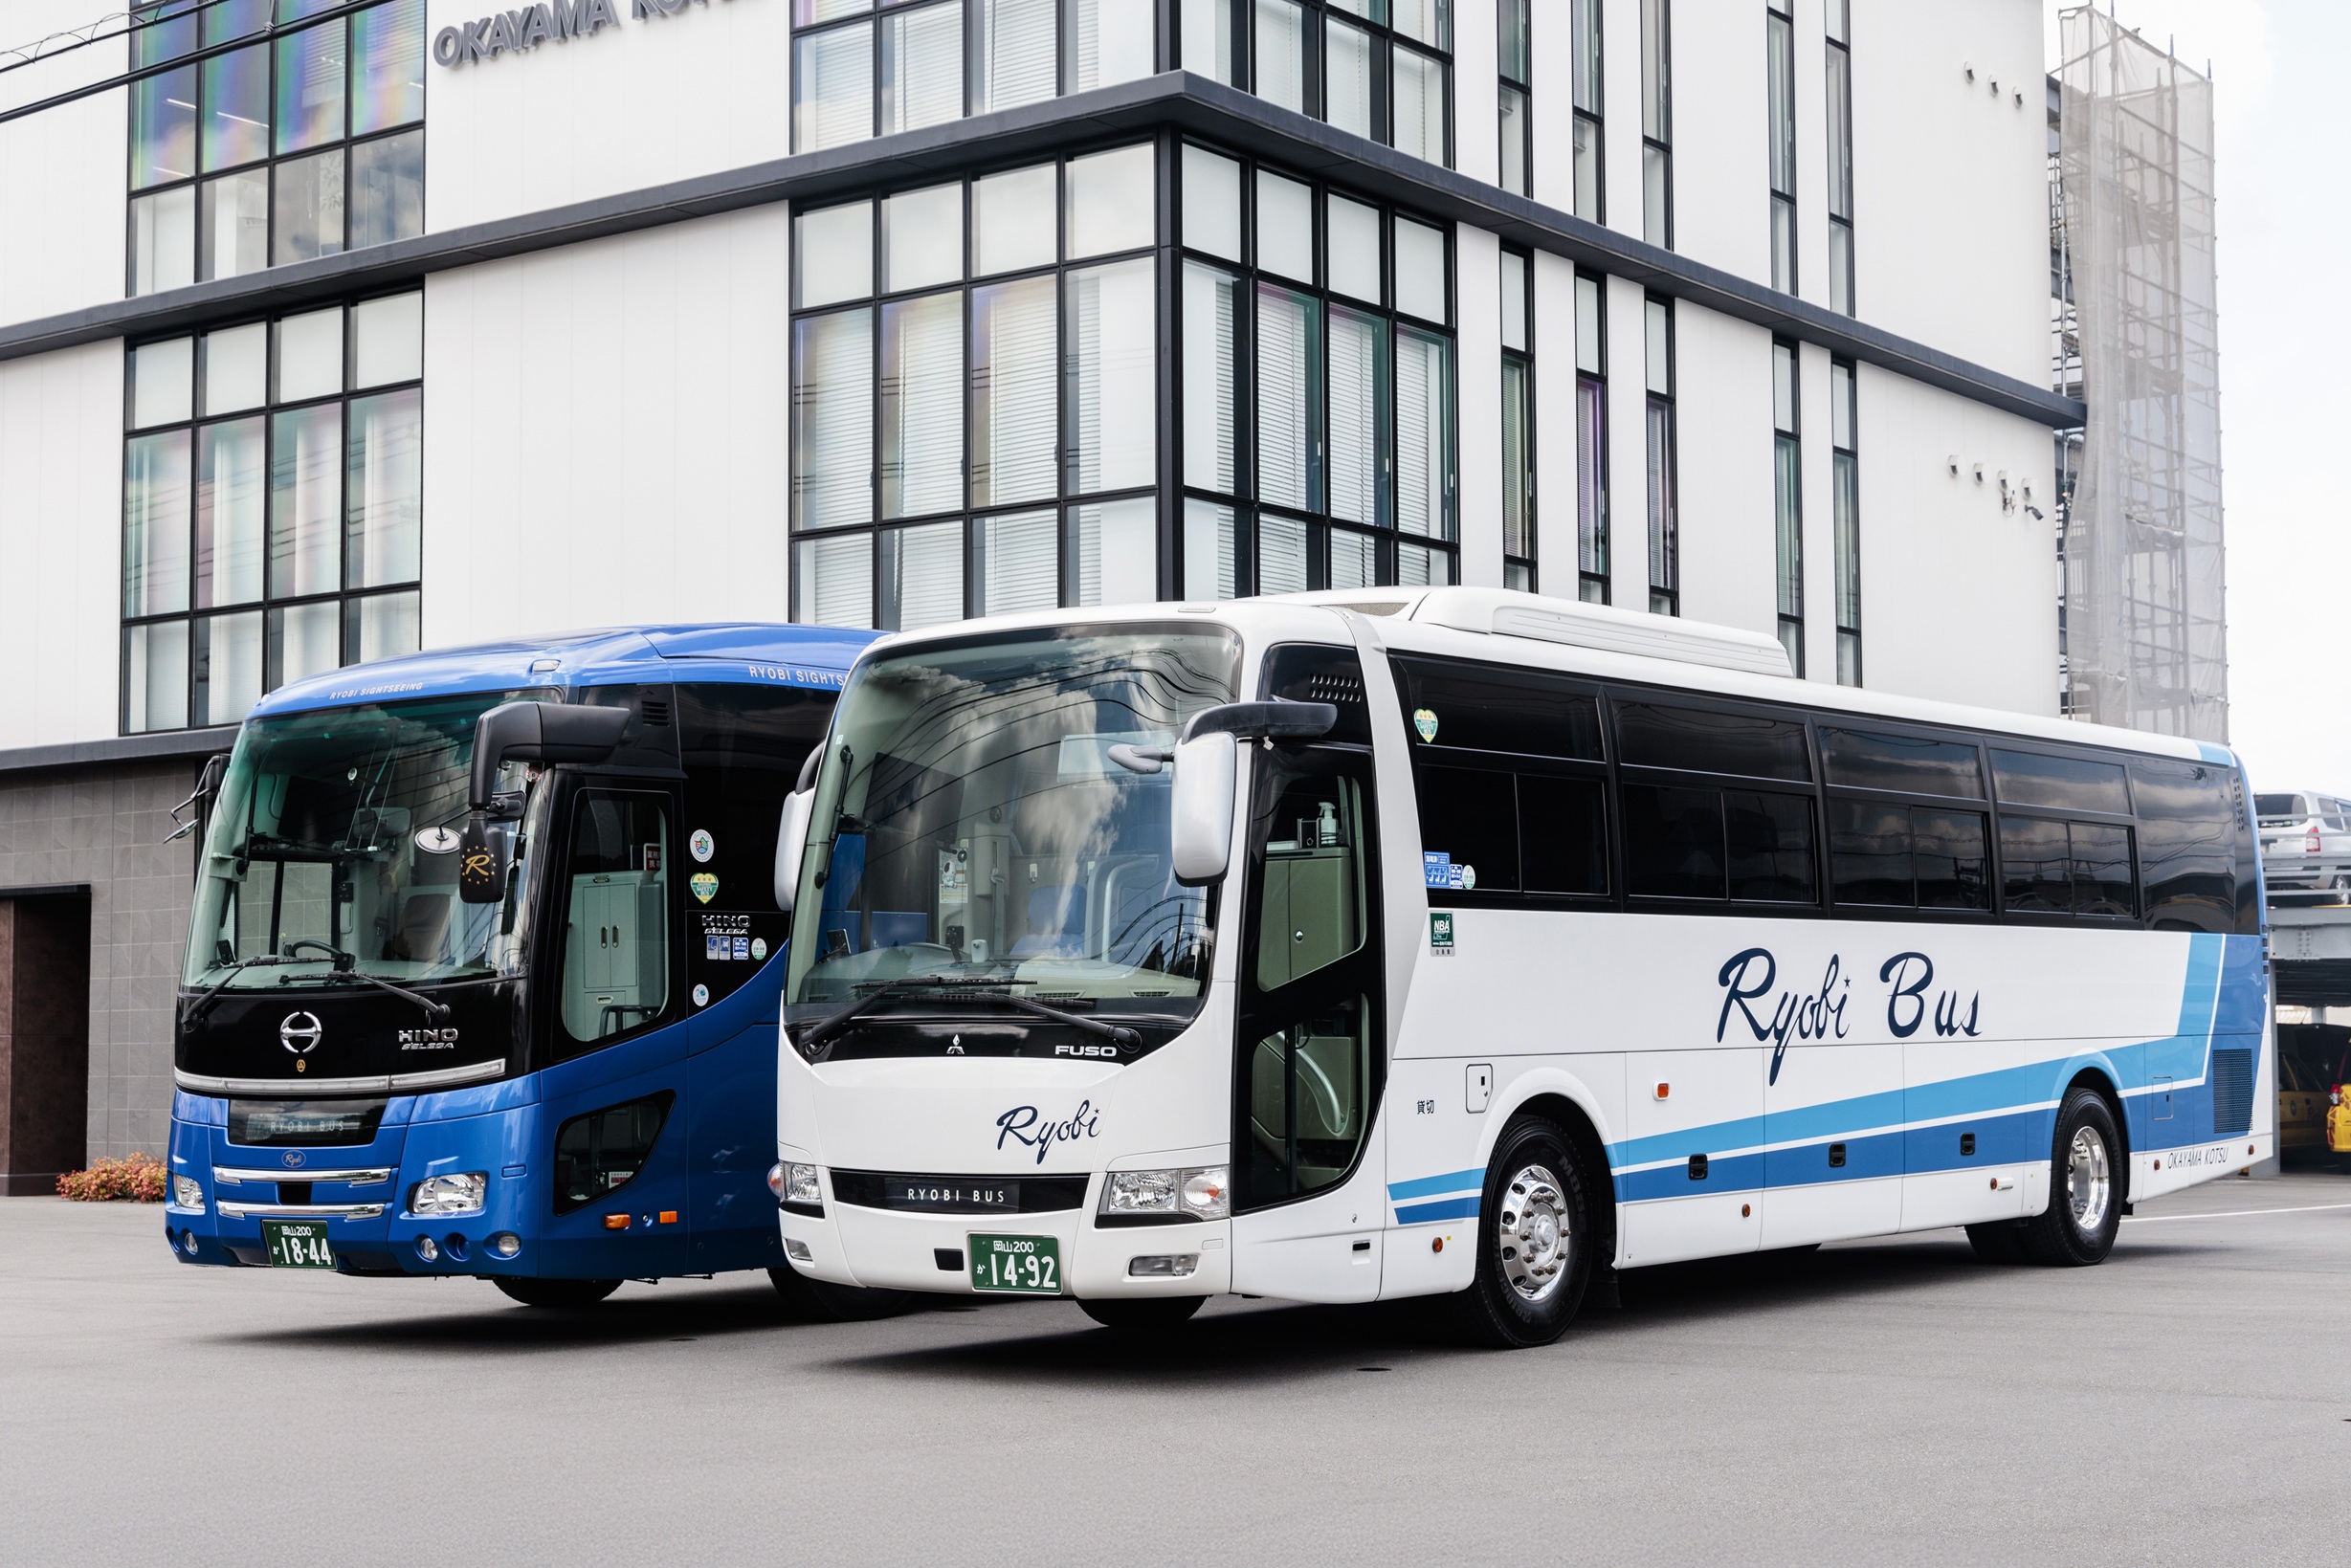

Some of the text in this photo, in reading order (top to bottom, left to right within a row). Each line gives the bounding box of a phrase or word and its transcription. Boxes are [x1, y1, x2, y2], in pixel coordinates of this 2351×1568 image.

[433, 0, 619, 68] OKAYAMA
[749, 666, 848, 686] RYOBI SIGHTS
[329, 682, 424, 700] RYOBI SIGHTSEEING
[465, 854, 490, 876] R
[701, 915, 750, 927] HINO
[1433, 919, 1451, 932] NBA
[1718, 947, 1983, 1087] Ryobi Bus
[398, 1028, 458, 1043] HINO
[1054, 1045, 1118, 1057] FUSO
[1416, 1099, 1435, 1115] 貸切
[270, 1120, 344, 1132] RYOBI BUS
[996, 1099, 1101, 1165] Ryobi
[2167, 1147, 2229, 1169] OKAYAMA KOTSU
[907, 1188, 1005, 1203] RYOBI BUS
[281, 1237, 332, 1265] 18-44
[977, 1253, 1057, 1288] か 14-92
